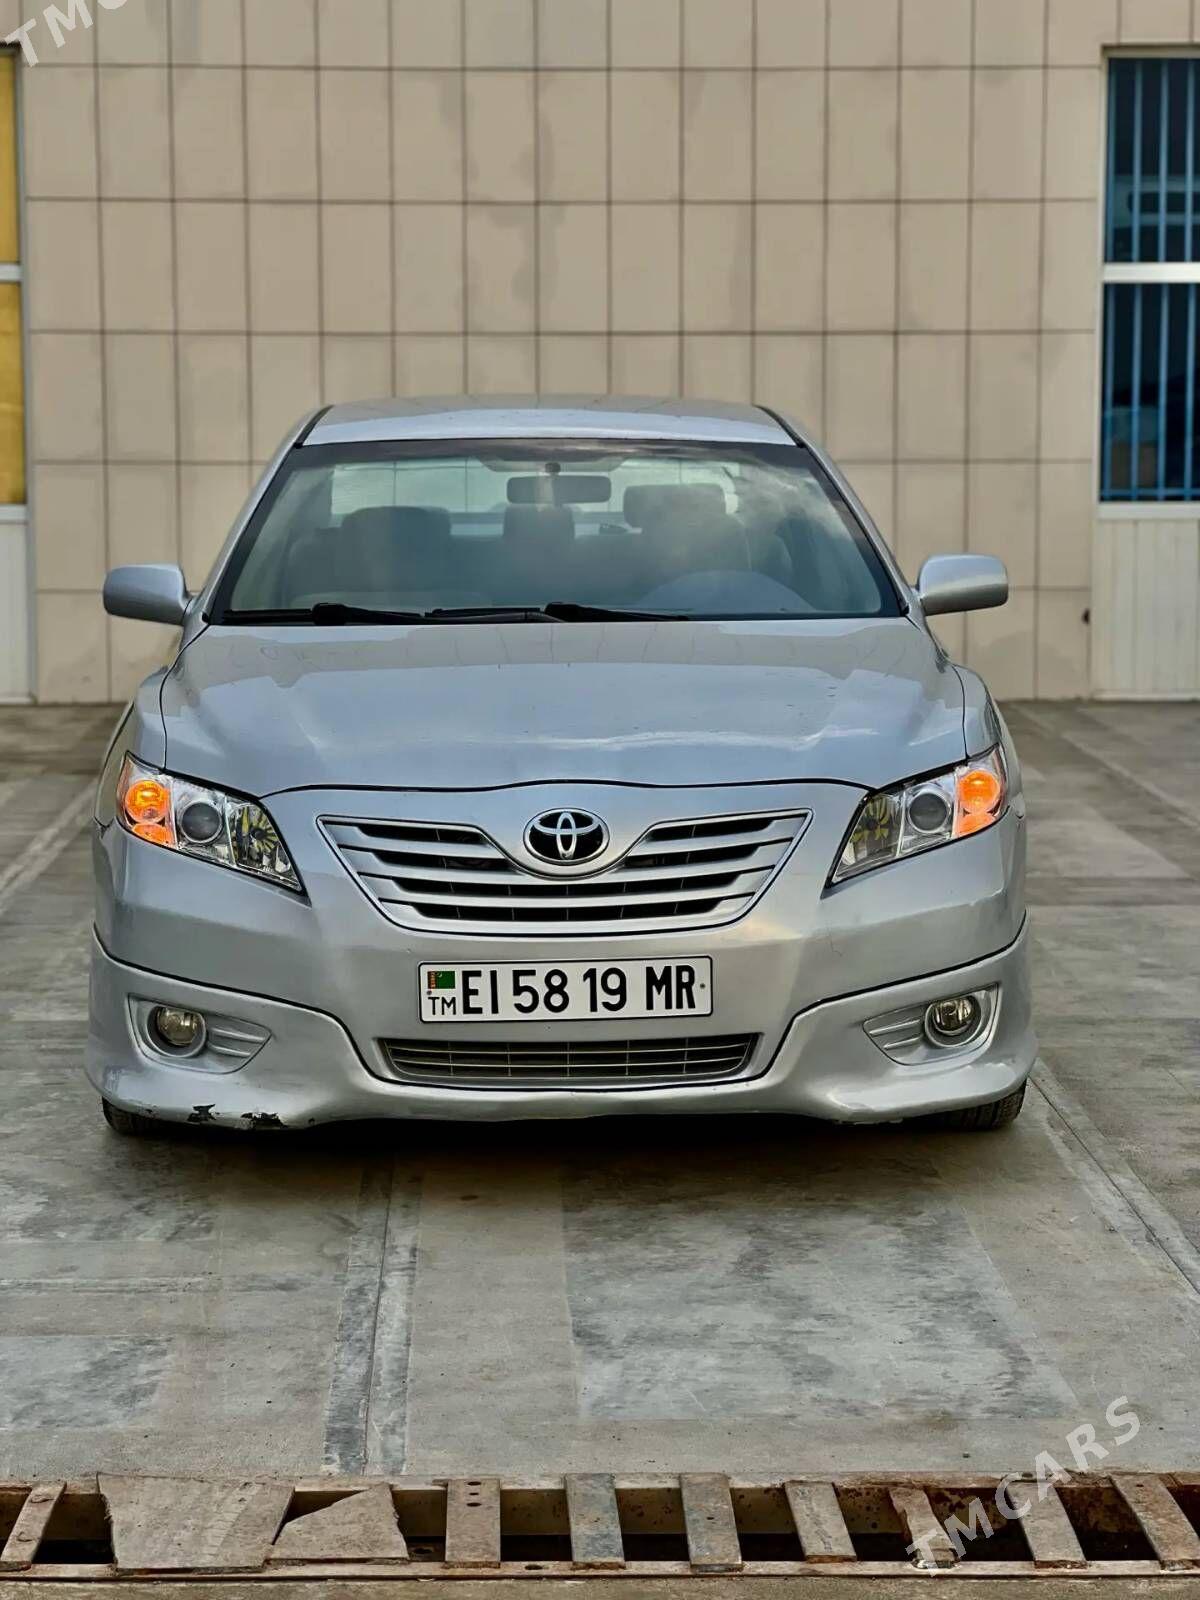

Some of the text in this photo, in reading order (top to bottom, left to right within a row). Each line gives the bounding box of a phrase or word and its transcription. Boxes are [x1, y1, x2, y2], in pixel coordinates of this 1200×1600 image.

[427, 996, 457, 1016] TM
[462, 965, 696, 1015] EI 58 19 MR
